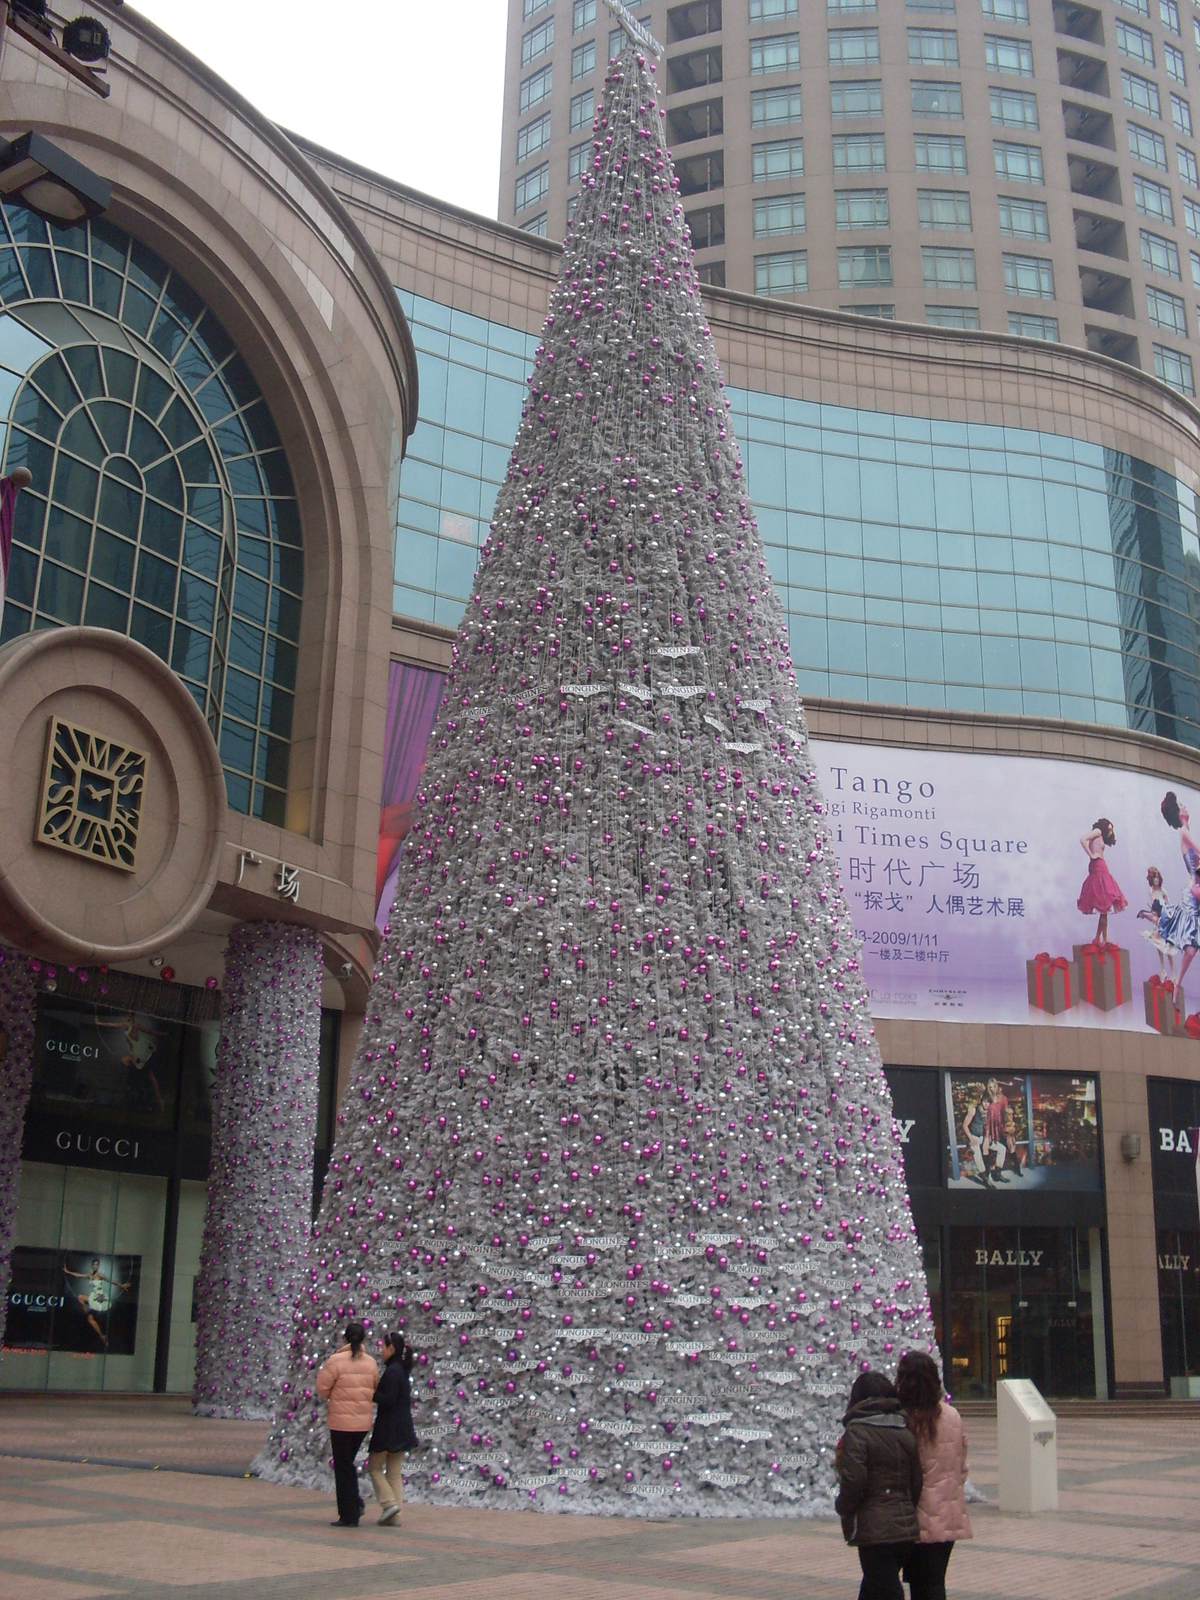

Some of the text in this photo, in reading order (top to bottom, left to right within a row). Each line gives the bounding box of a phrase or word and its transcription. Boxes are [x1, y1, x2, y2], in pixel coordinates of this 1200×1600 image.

[830, 767, 935, 804] Tango
[852, 801, 936, 820] Rigamonti
[855, 825, 929, 850] Times
[939, 830, 1028, 858] Square
[46, 1039, 99, 1059] GUCCI
[56, 1131, 139, 1158] GUCCI
[580, 1237, 629, 1246] LONGINES
[975, 1249, 1043, 1266] BALLY
[559, 1288, 607, 1297] LONGINES
[601, 1280, 649, 1289] LONGINES
[11, 1293, 65, 1307] GUCCI
[556, 1329, 606, 1337] LONGINES
